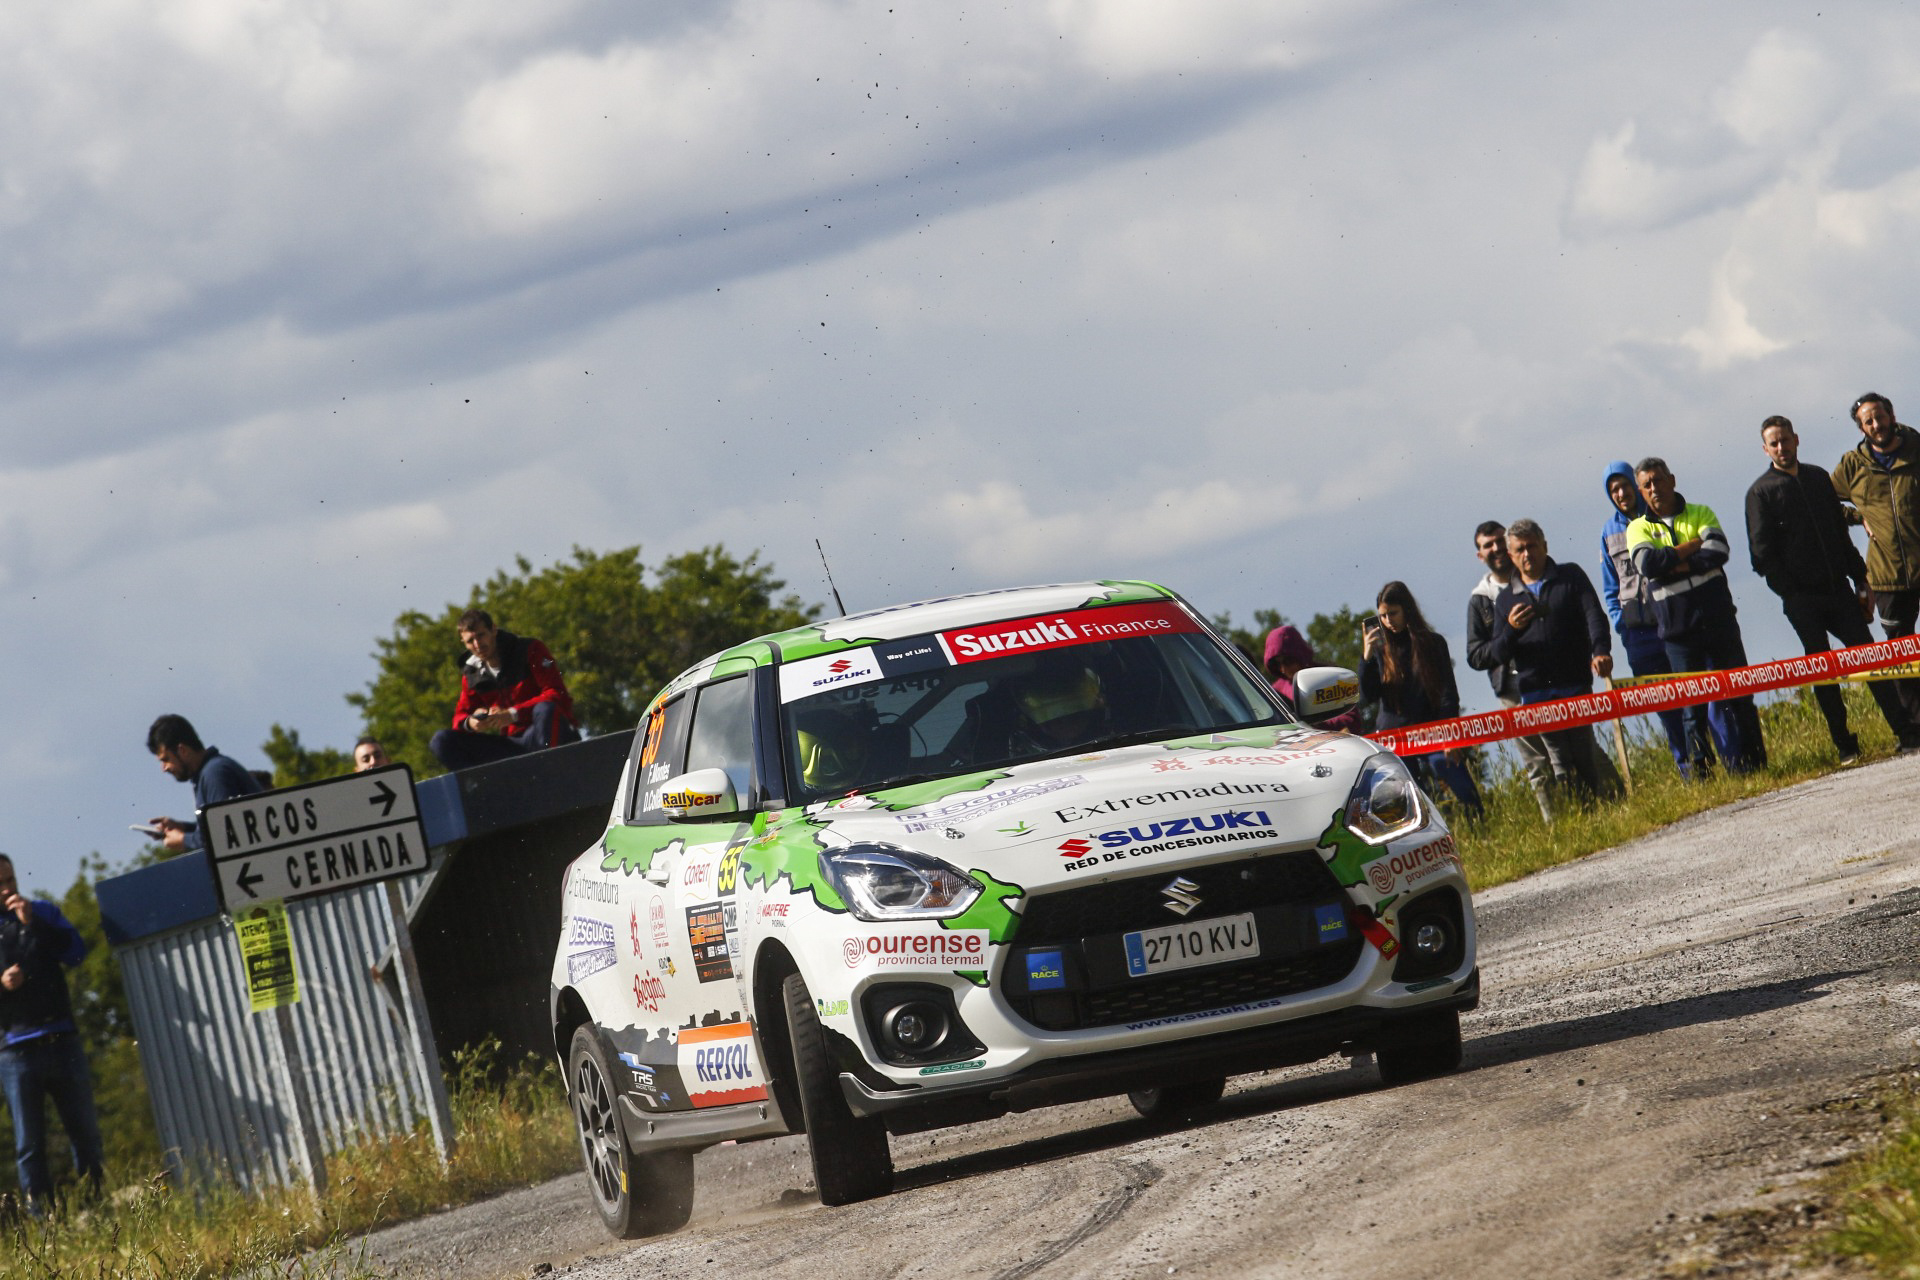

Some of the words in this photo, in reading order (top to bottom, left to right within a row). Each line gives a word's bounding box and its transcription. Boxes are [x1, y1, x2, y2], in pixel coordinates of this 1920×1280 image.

[954, 618, 1077, 657] Suzuki
[1080, 617, 1172, 637] Finance
[887, 653, 903, 661] Way
[1836, 643, 1892, 669] PROHIBIDO
[812, 668, 871, 687] SUZUKI
[1729, 664, 1784, 689] PROHIBIDO
[1783, 656, 1828, 678] PUBLICO
[1621, 683, 1676, 708] PROHIBIDO
[1675, 676, 1720, 698] PUBLICO
[1513, 702, 1568, 729] PROHIBIDO
[1567, 695, 1612, 719] PUBLICO
[1406, 722, 1460, 748] PROHIBIDO
[1460, 714, 1504, 738] PUBLICO
[662, 792, 722, 808] Rallycar
[1053, 781, 1290, 824] Extremadura
[224, 797, 318, 850] ARCOS
[1098, 810, 1273, 848] SUZUKI
[286, 831, 413, 890] CERNADA
[1064, 856, 1099, 872] RED
[1104, 851, 1127, 863] DE
[1128, 829, 1279, 857] CONCESIONARIOS
[718, 845, 744, 892] 55
[574, 868, 619, 905] Extremadura
[762, 903, 791, 918] MAPFRE
[1320, 920, 1343, 932] RACE
[569, 915, 616, 947] DESGUACE
[866, 934, 981, 955] ourense
[1145, 931, 1204, 965] 2710
[1209, 921, 1254, 954] KVJ
[877, 954, 937, 967] provincia
[941, 954, 984, 965] termal
[1031, 969, 1060, 979] RACE
[1133, 958, 1142, 968] E
[1125, 998, 1282, 1031] www.suzuki.es
[631, 1070, 654, 1086] TRS
[696, 1043, 753, 1082] REPSOL
[925, 1061, 980, 1073] TRADISA
